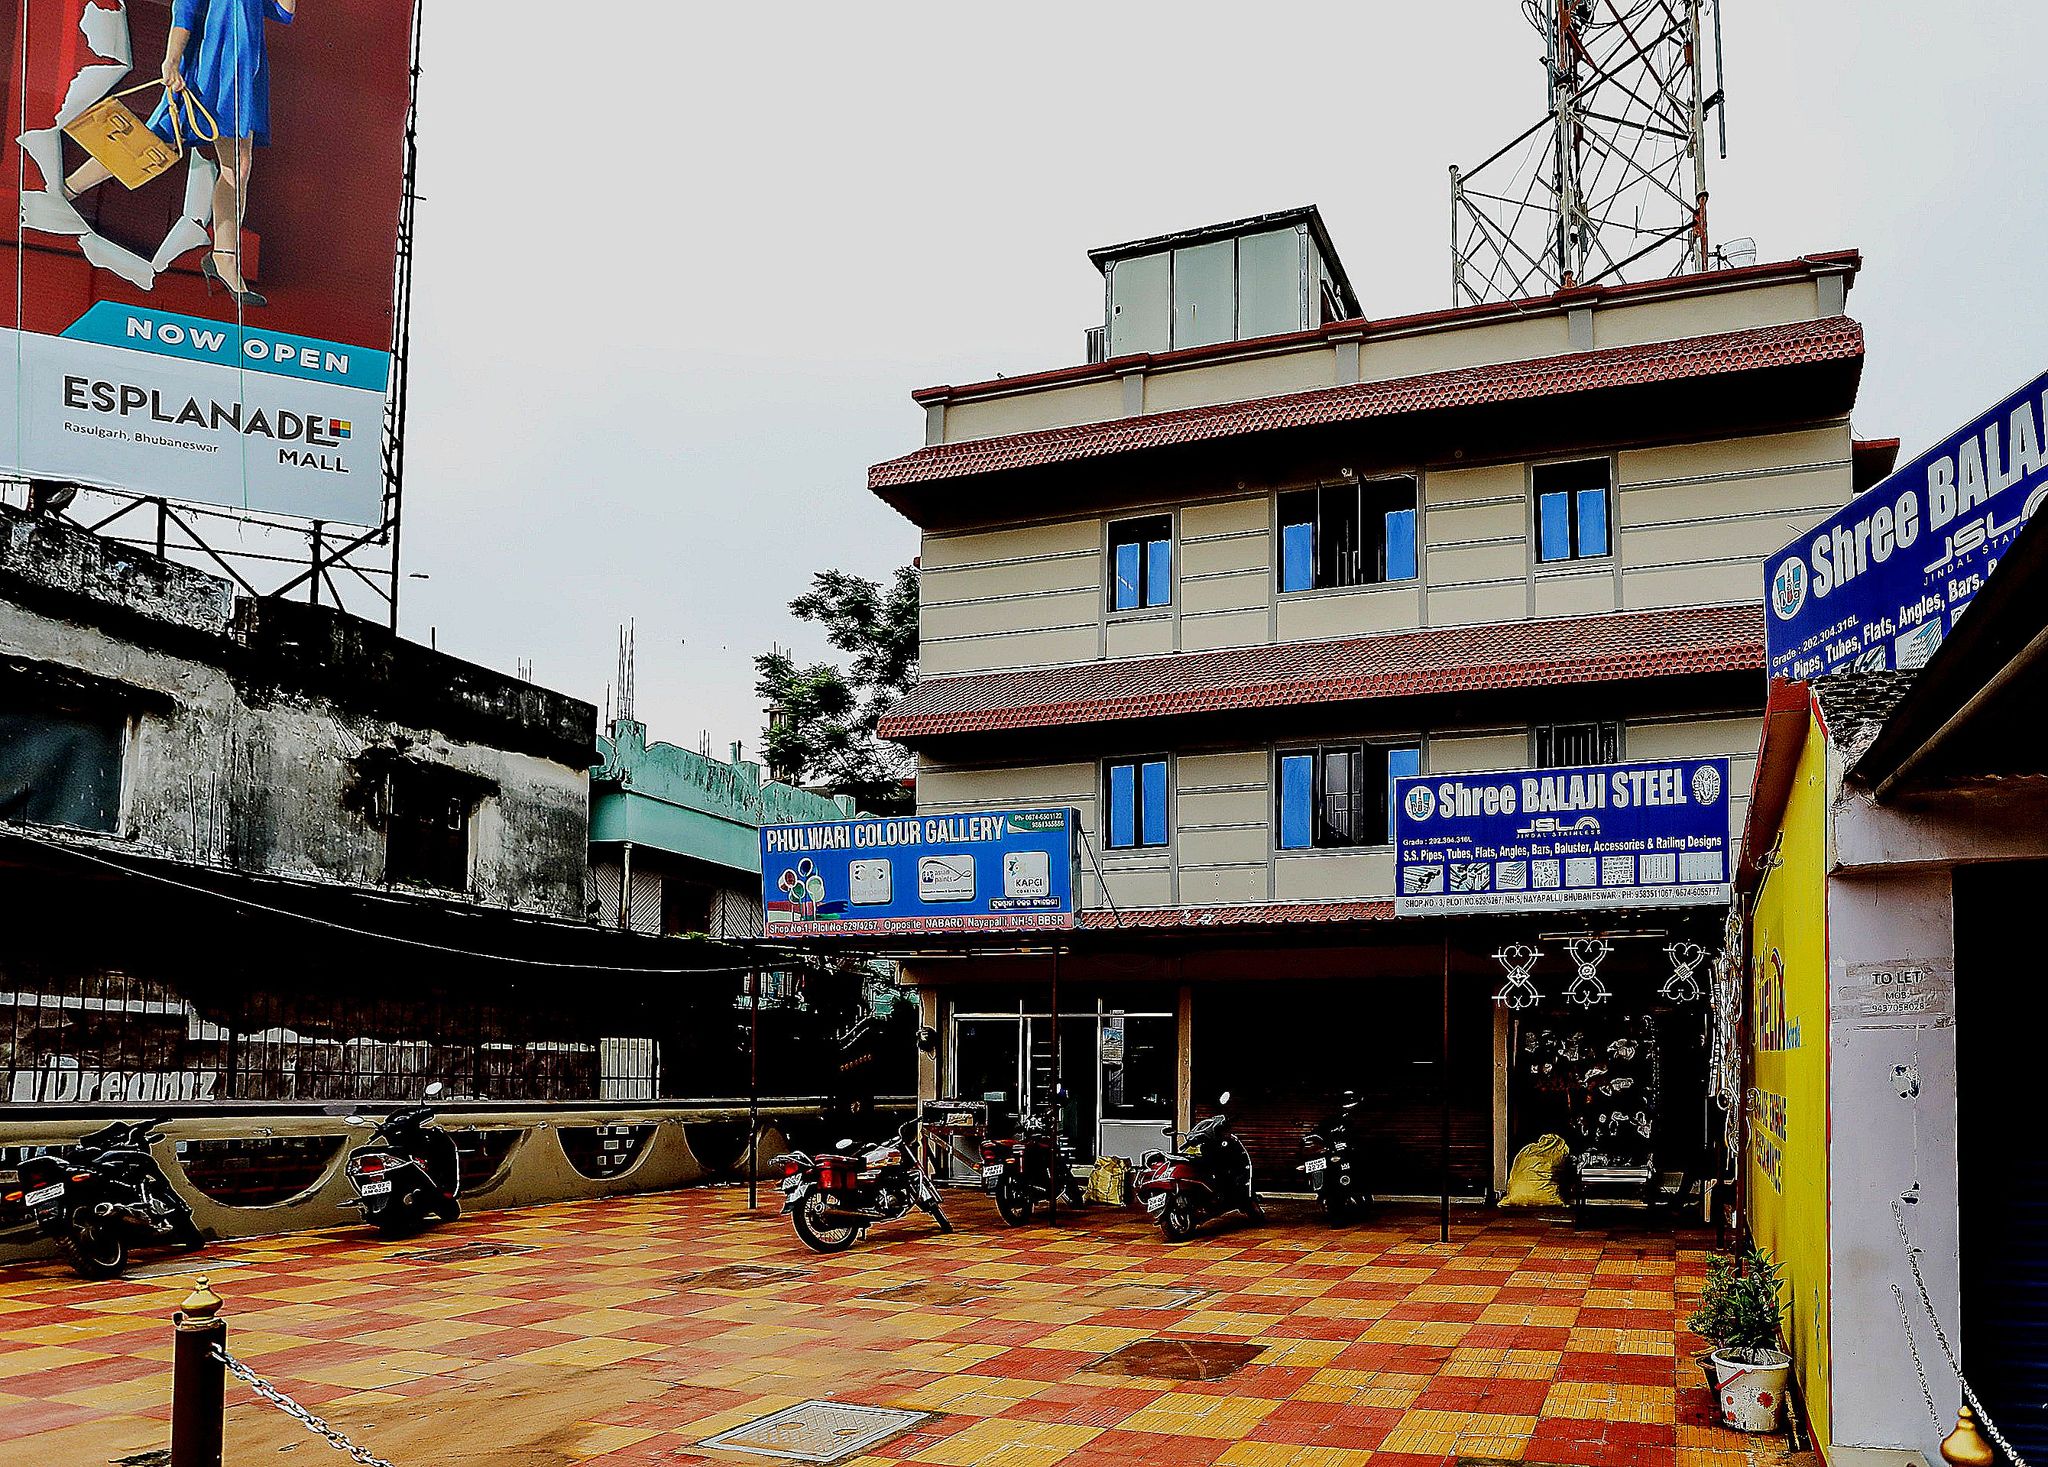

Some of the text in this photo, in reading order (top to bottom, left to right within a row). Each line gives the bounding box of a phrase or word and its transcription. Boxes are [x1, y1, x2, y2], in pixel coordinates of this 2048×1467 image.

[126, 316, 350, 374] NOW OPEN
[63, 375, 341, 448] ESPLANADE
[64, 421, 219, 454] Rasulgarh, Bhubaneswar
[278, 448, 350, 473] MALL
[1811, 490, 1919, 599] Shree
[1923, 554, 1972, 586] JINDAL
[1982, 526, 2024, 555] STAI
[1924, 511, 2022, 574] JSL
[1772, 649, 1797, 668] Grade
[1802, 614, 1860, 652] 202.304.316L
[1793, 655, 1824, 681] Pipes,
[1825, 636, 1862, 664] Tubes,
[1863, 616, 1896, 646] Flats,
[1899, 592, 1946, 628] Angles,
[1948, 573, 1985, 603] Bars,
[1438, 768, 1687, 818] Shree BALAJI STEEL
[767, 815, 1005, 853] PHULWARI COLOUR GALLERY
[1516, 818, 1575, 833] JSL
[1516, 829, 1601, 839] JINDAL STAINLESS
[1403, 835, 1722, 863] S.S. Pipes, Tubes, Flats, Angles, Bars, Baluster, Accessories & Railing Designs
[1405, 899, 1423, 908] SHOP
[1446, 897, 1462, 906] PLOT
[1563, 890, 1617, 901] BHUBANESWAR
[769, 924, 789, 934] Shop
[812, 923, 829, 932] Plot
[884, 919, 921, 931] Opposite
[925, 918, 966, 929] NABARD,
[967, 916, 1010, 929] Nayapalli,
[1011, 915, 1036, 927] NH-5,
[1037, 915, 1065, 926] BBSR
[1871, 970, 1921, 985] TO LET
[1871, 1002, 1925, 1012] 9437058028
